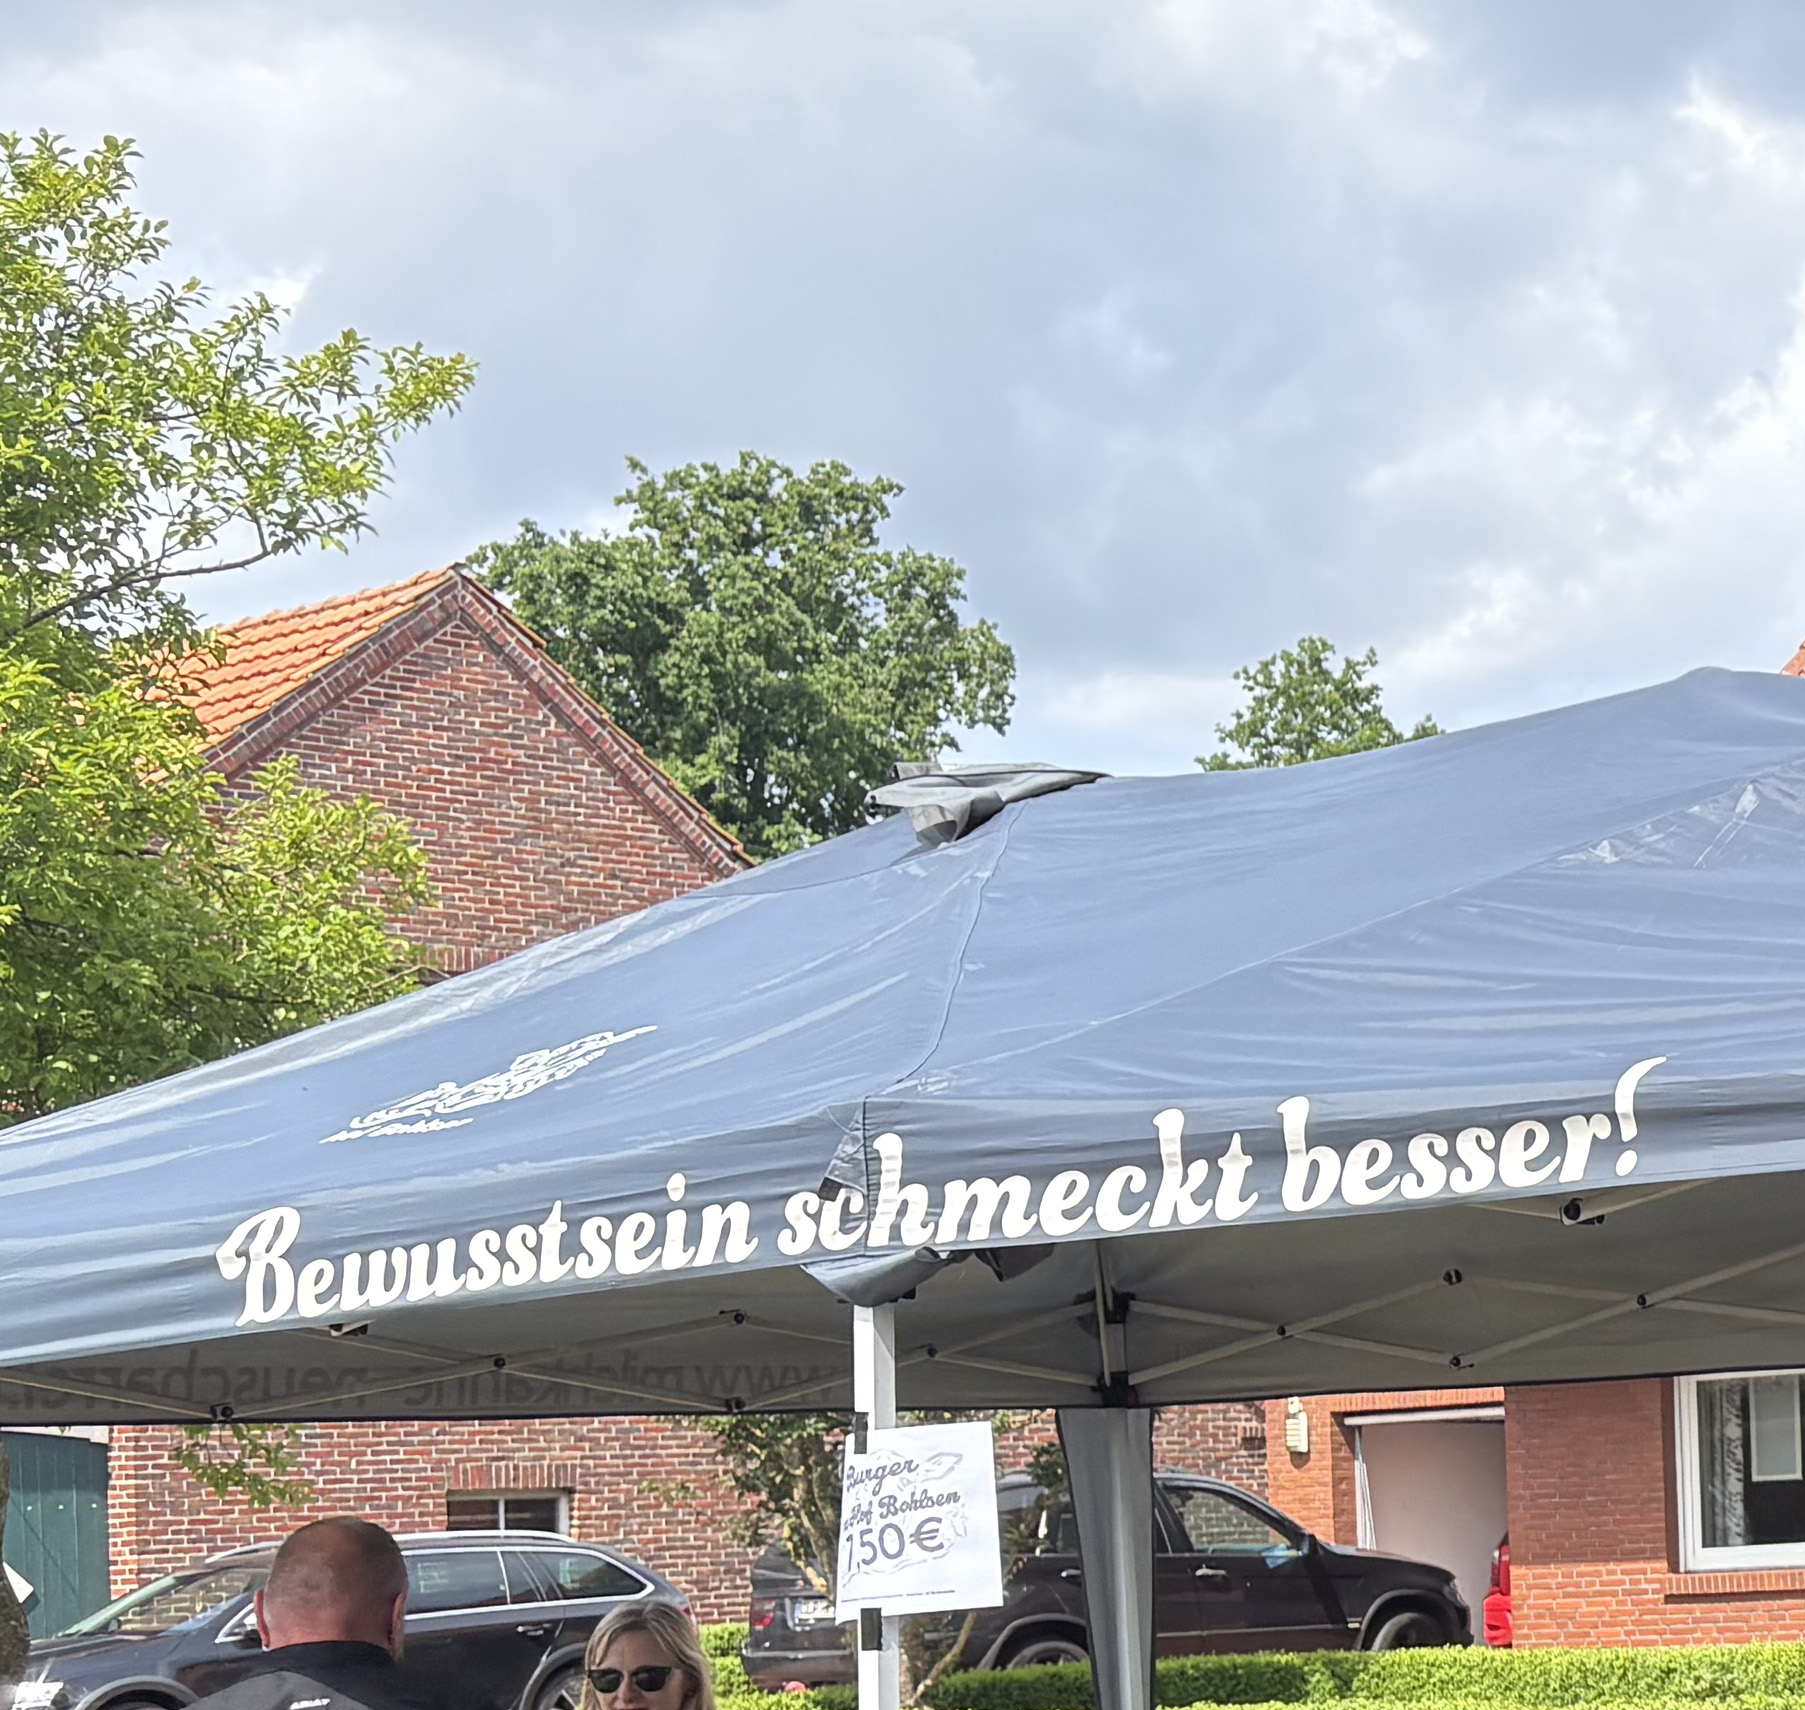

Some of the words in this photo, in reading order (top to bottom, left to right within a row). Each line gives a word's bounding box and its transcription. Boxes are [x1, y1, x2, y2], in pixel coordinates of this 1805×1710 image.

[215, 1172, 759, 1328] Bewusstsein
[777, 1108, 1259, 1256] schmeckt
[1276, 1056, 1667, 1212] besser!
[878, 1489, 961, 1520] Bohlsen
